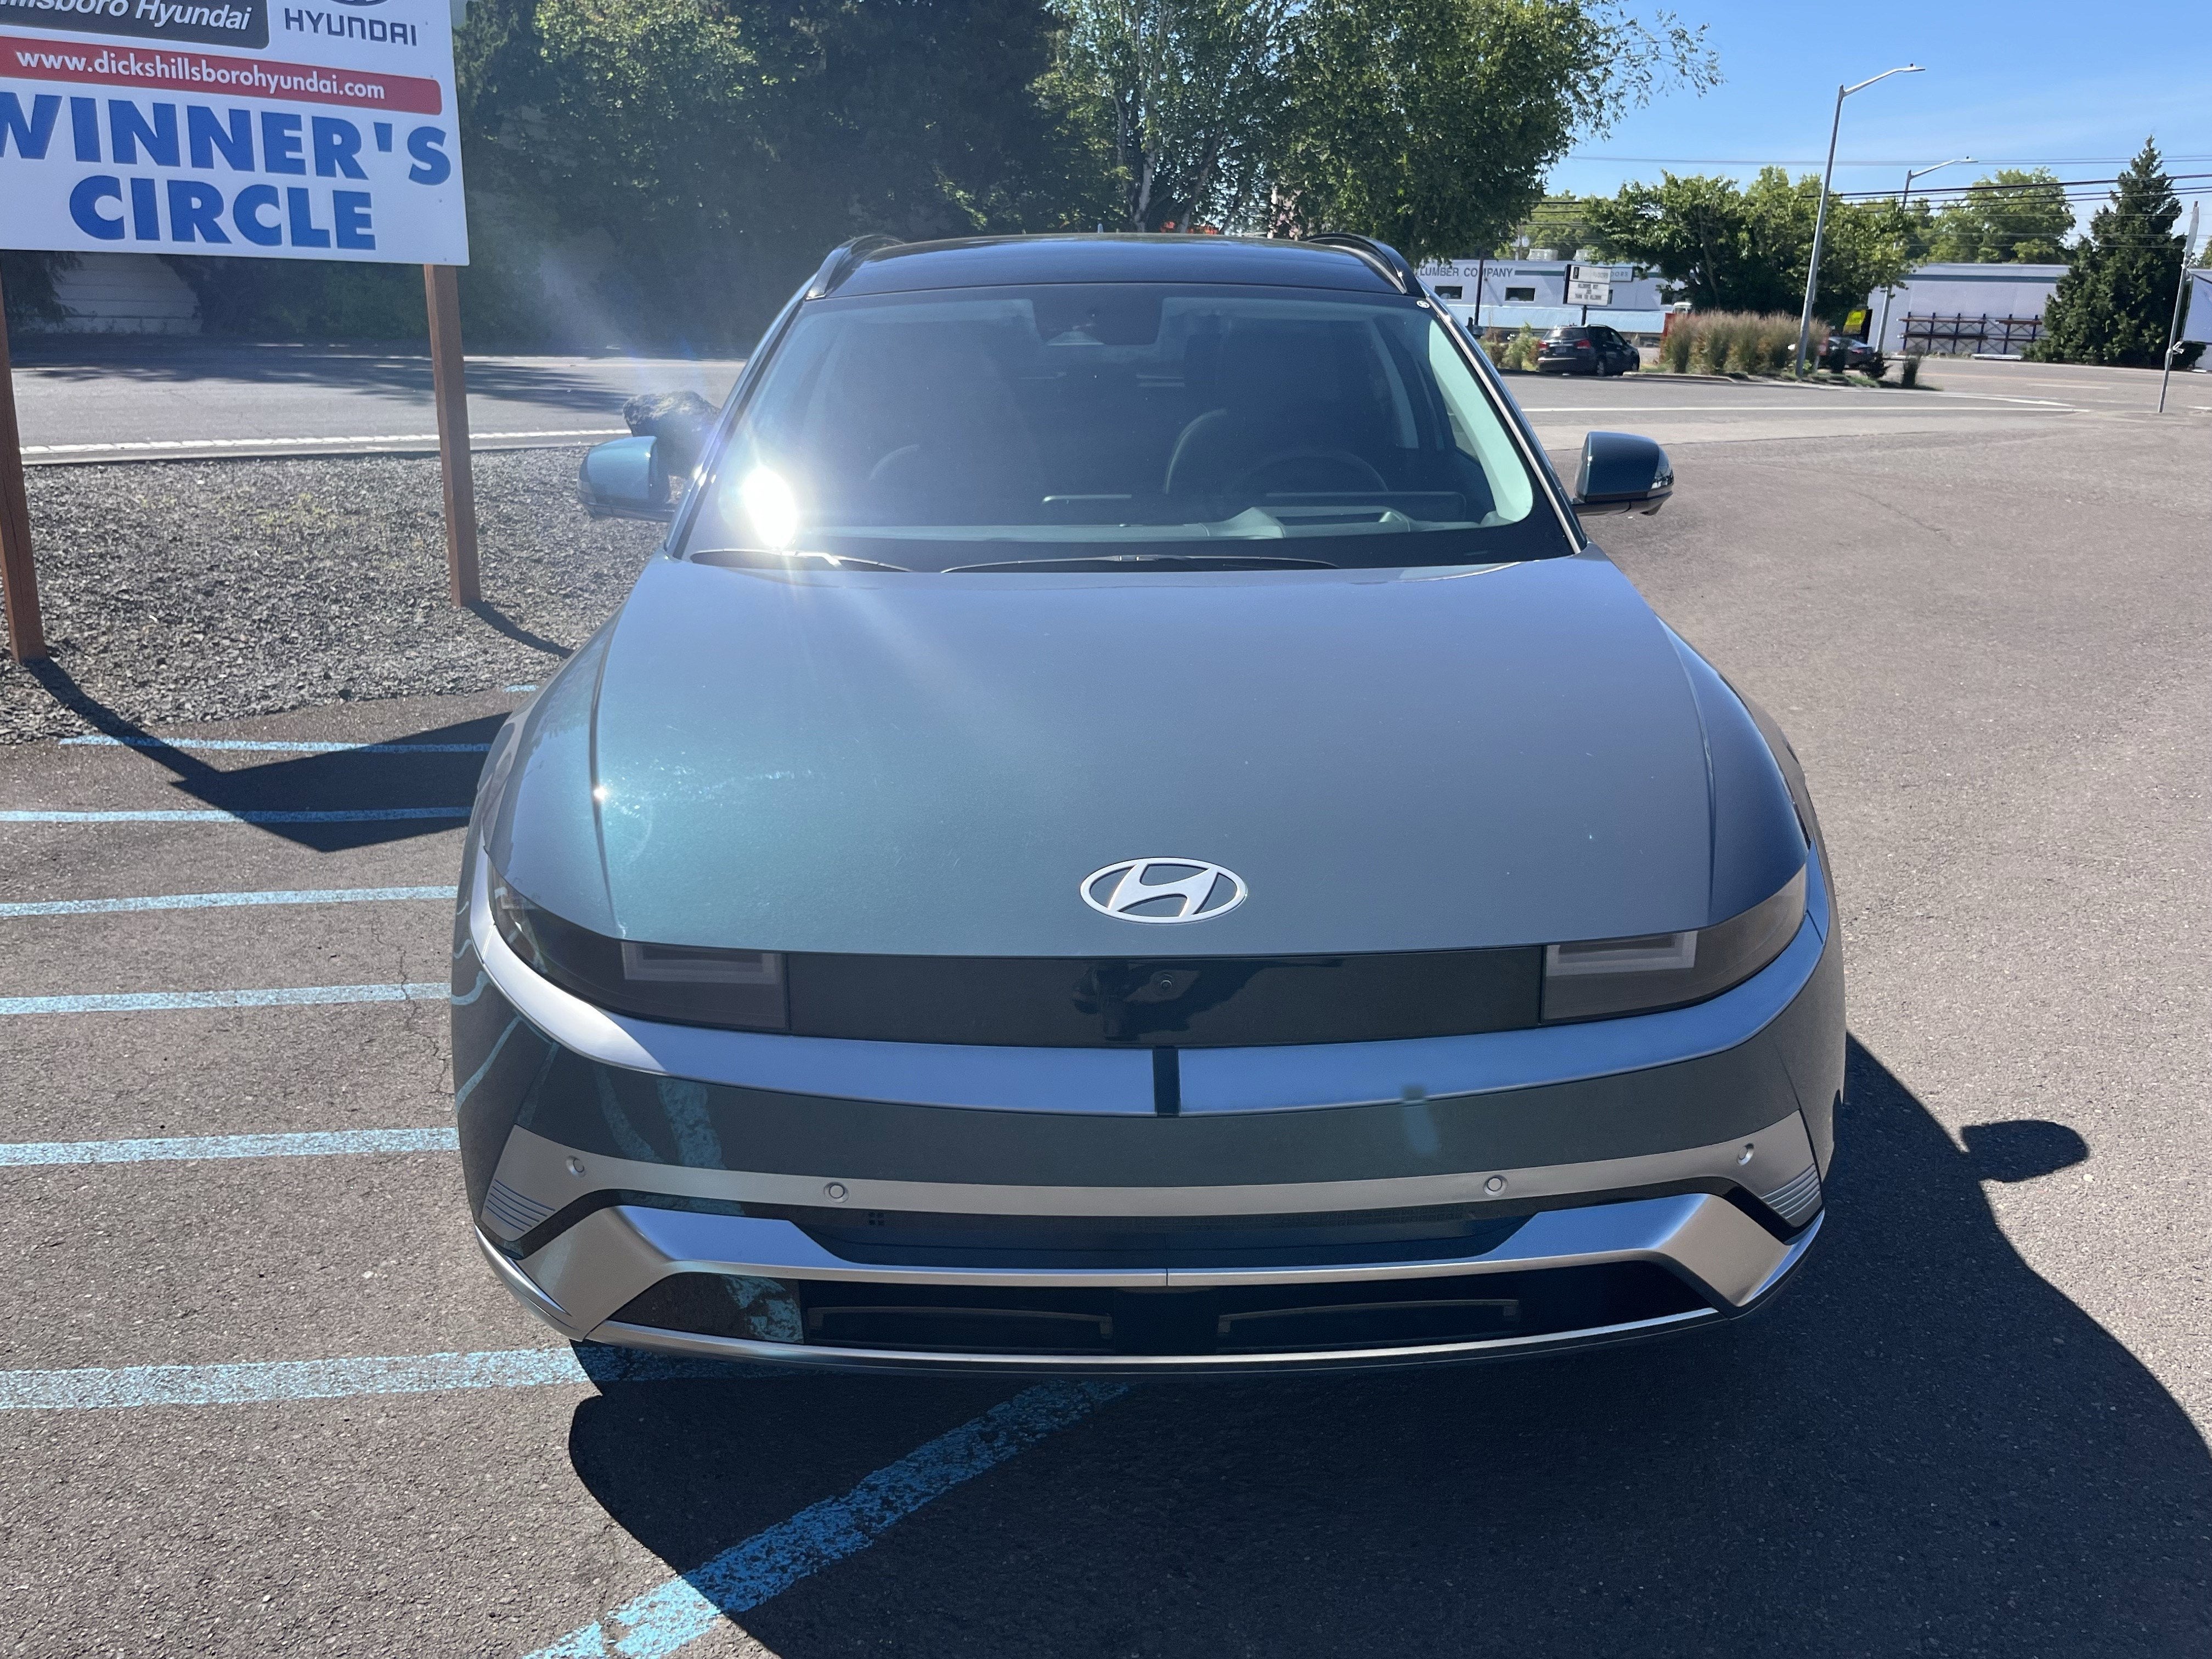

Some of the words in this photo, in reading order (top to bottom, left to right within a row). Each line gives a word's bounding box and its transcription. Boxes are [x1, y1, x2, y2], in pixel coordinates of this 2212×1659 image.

[135, 0, 252, 30] Hyundai
[284, 8, 417, 47] HYUNDAI
[15, 50, 386, 99] www.dickshillsborohyundai.com
[0, 92, 452, 186] WINNER'S
[69, 175, 376, 250] CIRCLE
[1420, 267, 1459, 276] LUMBER
